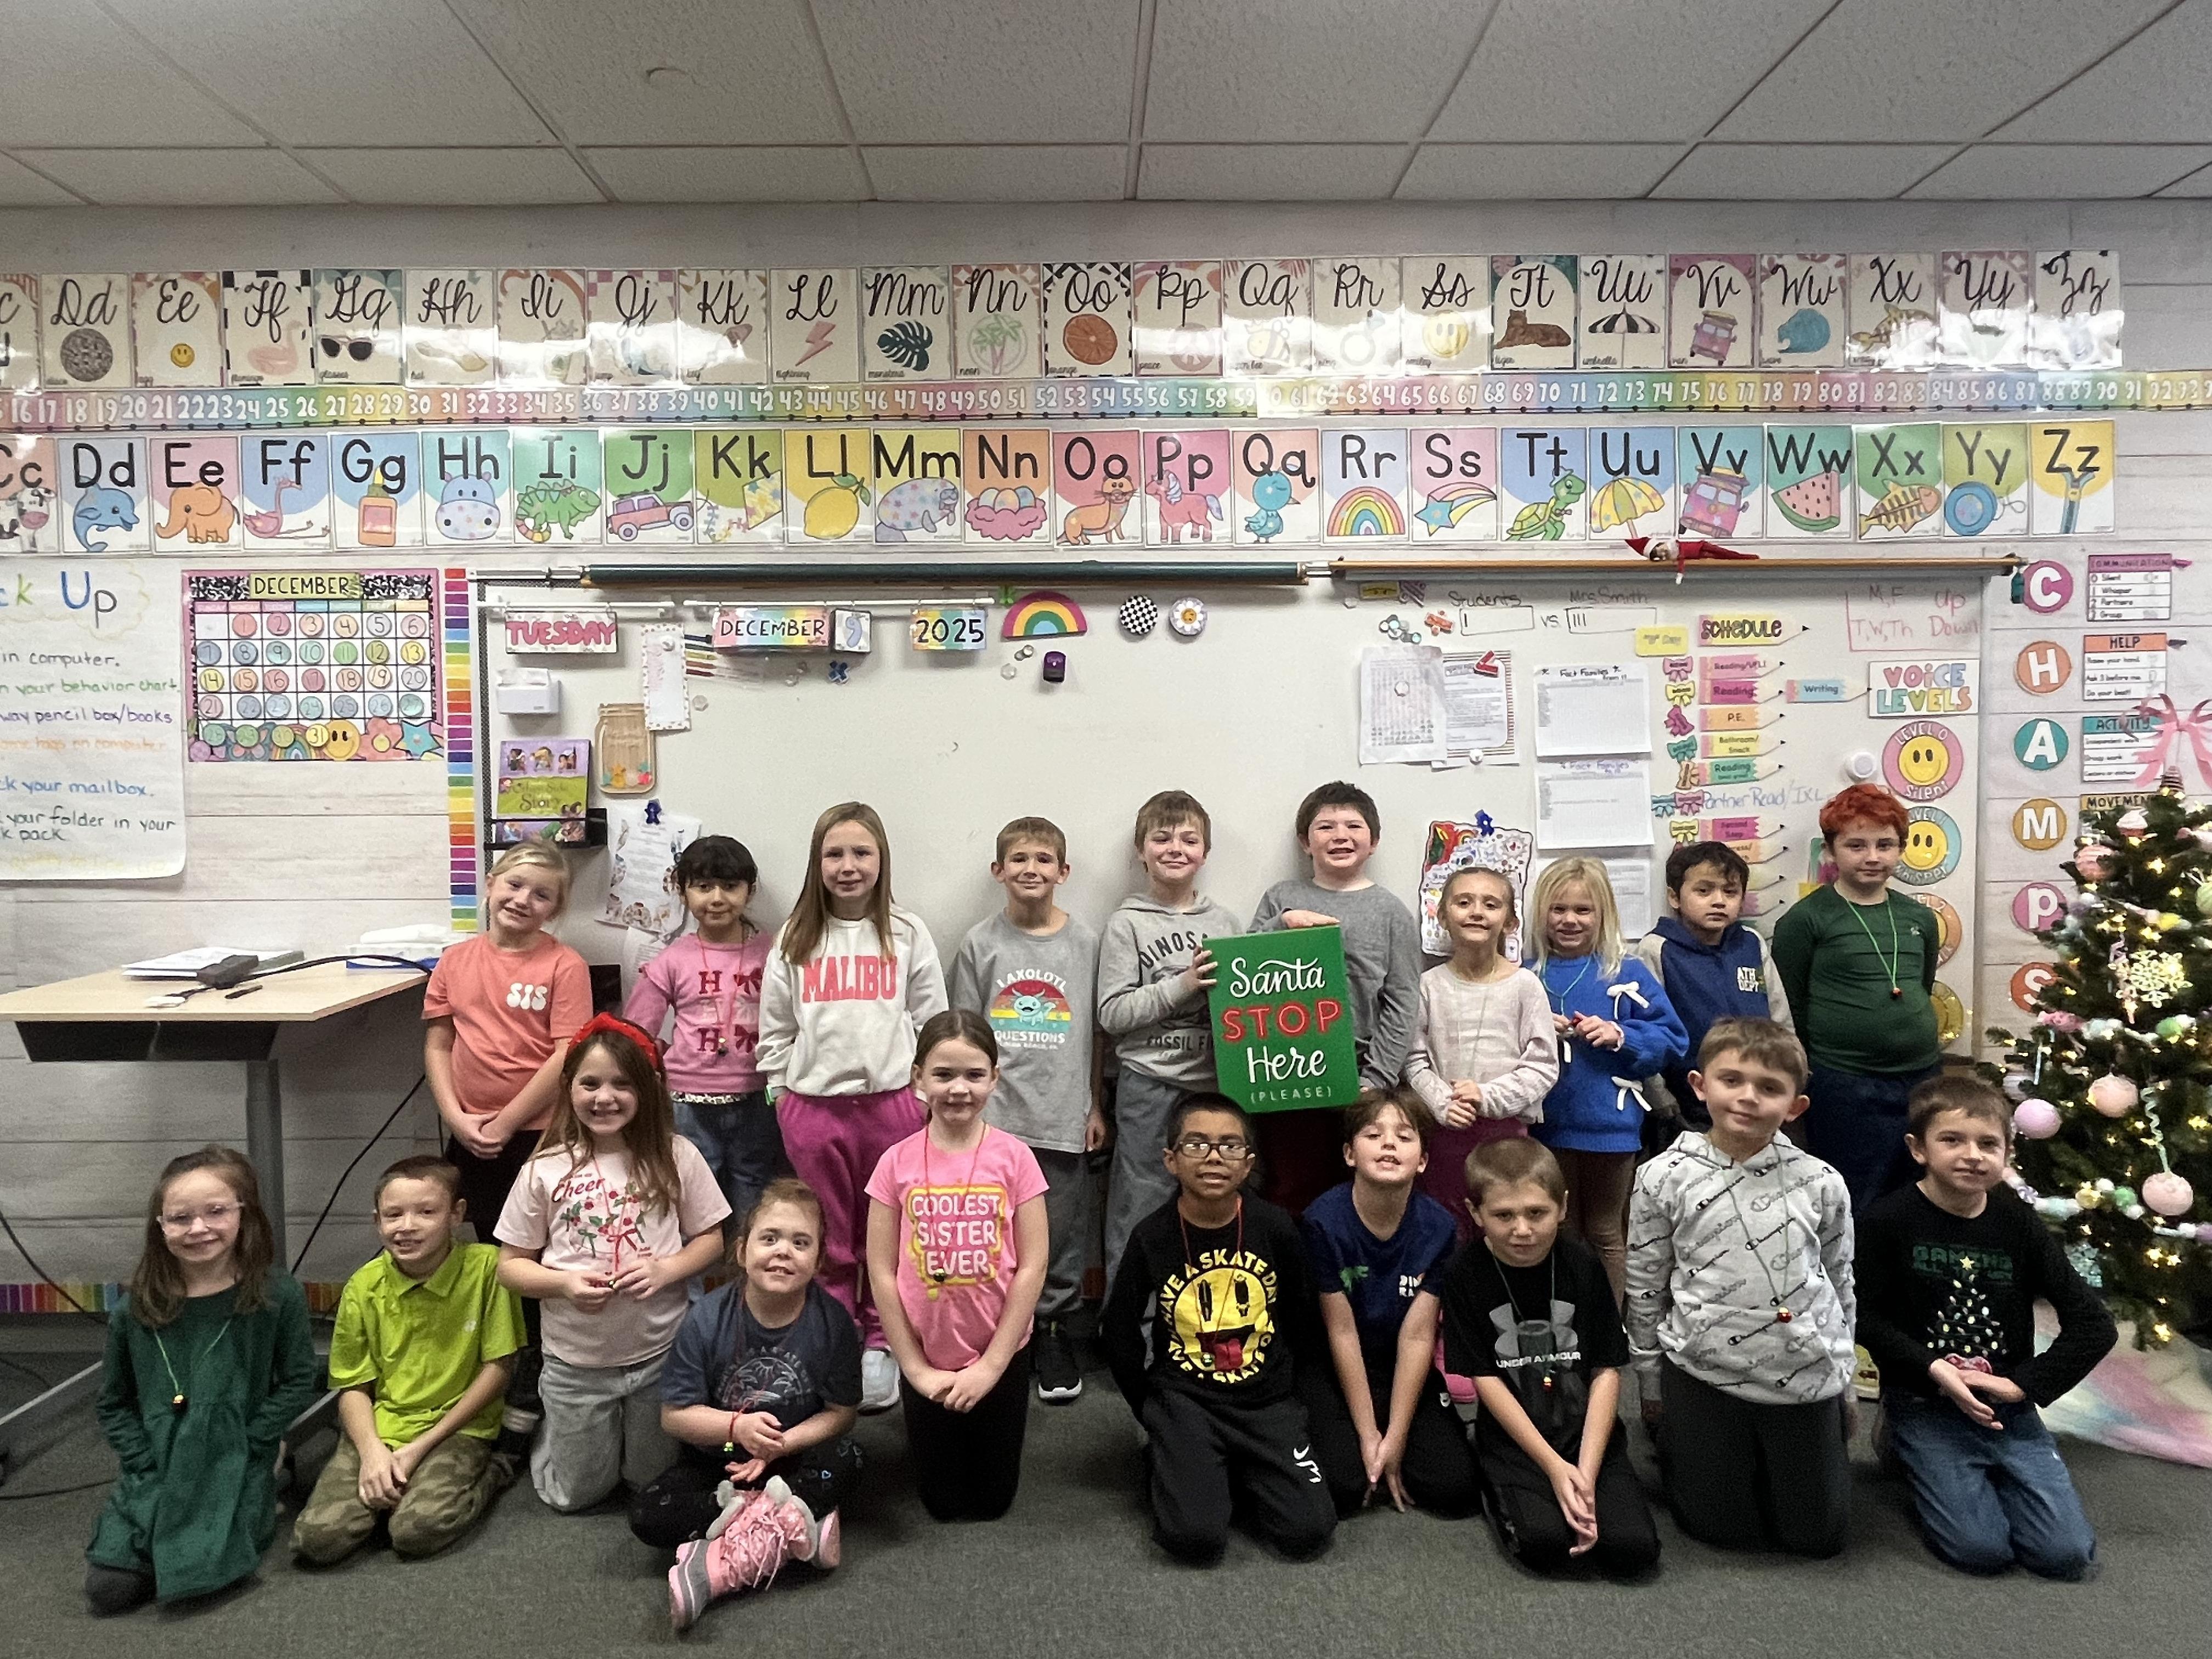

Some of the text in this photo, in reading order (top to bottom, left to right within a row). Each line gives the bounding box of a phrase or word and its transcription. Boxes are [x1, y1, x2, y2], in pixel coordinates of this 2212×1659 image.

[868, 272, 944, 317] Mm
[966, 268, 1026, 314] Nn
[1064, 269, 1118, 313] Oo
[1238, 263, 1298, 317] Qq
[1333, 264, 1384, 308] Rr
[1510, 263, 1554, 309] Tt
[1592, 259, 1652, 303] Uu
[1687, 264, 1740, 308] Vv
[1771, 264, 1837, 306] Ww
[1870, 256, 1922, 303] Xx
[1954, 259, 2014, 315] Yy
[51, 278, 117, 326] Dd
[157, 279, 200, 323] Ee
[245, 280, 289, 342] Ff
[325, 275, 392, 338] Gg
[417, 278, 482, 324] Hh
[521, 274, 563, 319] Ii
[697, 280, 749, 324] Kk
[786, 274, 837, 321] Ll
[1155, 266, 1209, 327] Pp
[442, 393, 458, 414] 31
[693, 391, 718, 411] 40
[894, 390, 917, 409] 47
[1036, 389, 1058, 407] 52
[1401, 383, 1421, 404] 65
[1539, 381, 1560, 402] 70
[1763, 381, 1782, 400] 78
[2125, 380, 2142, 399] 91
[12, 397, 32, 422] 16
[123, 395, 146, 419] 20
[266, 397, 289, 417] 25
[74, 443, 136, 488] Dd
[165, 443, 224, 487] Ee
[261, 440, 315, 484] Ff
[439, 437, 500, 480] Hh
[539, 436, 577, 478] Ii
[622, 435, 669, 492] Jj
[712, 435, 771, 478] Kk
[806, 435, 848, 478] Ll
[876, 435, 962, 478] Mm
[978, 435, 1038, 478] Nn
[1065, 436, 1128, 480] Oo
[1156, 436, 1214, 492] Pp
[1242, 433, 1316, 488] Qq
[1341, 435, 1397, 478] Rr
[1425, 433, 1481, 477] Ss
[1516, 432, 1567, 477] Tt
[1601, 432, 1659, 476] Uu
[1691, 432, 1747, 476] Vv
[1767, 432, 1852, 475] Ww
[1871, 433, 1926, 477] Xx
[1955, 431, 2010, 485] Yy
[2044, 428, 2100, 473] Zz
[341, 439, 406, 494] Gg
[61, 571, 117, 629] Up
[254, 577, 349, 595] DECEMBER
[1448, 590, 1521, 607] Students
[2032, 568, 2062, 607] C
[275, 614, 284, 631] 2
[307, 616, 318, 631] 3
[374, 618, 384, 631] 5
[506, 620, 615, 646] TUESDAY
[720, 617, 862, 647] DECEMBER 9
[917, 618, 985, 644] 2025
[303, 646, 320, 659] 10
[369, 644, 384, 659] 12
[2110, 637, 2140, 648] HELP
[29, 651, 120, 668] computer.
[2028, 650, 2059, 686] H
[16, 684, 54, 696] your
[61, 679, 135, 692] behavior
[205, 674, 219, 687] 14
[404, 672, 424, 685] 20
[1713, 686, 1753, 697] Reading
[1804, 685, 1838, 695] Writing
[1877, 686, 1972, 713] LEVELS
[35, 708, 86, 723] pencil
[1728, 713, 1745, 721] P.E.
[311, 727, 324, 743] 31
[1895, 722, 1932, 744] LEVEL
[2023, 721, 2057, 763] A
[1715, 764, 1751, 772] Reading
[22, 780, 155, 797] your mailbox.
[1906, 781, 1948, 799] Silent
[7, 805, 176, 832] your folder in your
[2022, 808, 2059, 839] M
[20, 829, 65, 843] pack
[1139, 931, 1207, 968] DINOS
[698, 970, 723, 994] H
[803, 956, 898, 1004] MALIBU
[1007, 969, 1066, 992] AXOLOTL
[1230, 957, 1325, 998] Santa
[1737, 967, 1756, 981] ATH
[1737, 980, 1759, 992] DEPT
[507, 982, 547, 1011] SIS
[1223, 1000, 1340, 1039] STOP
[697, 1028, 720, 1052] H
[994, 1031, 1065, 1043] QUESTIONS
[1246, 1047, 1327, 1083] Here
[1250, 1086, 1331, 1103] (PLEASE)
[552, 1178, 605, 1202] Cheer
[912, 1194, 1002, 1217] COOLEST
[917, 1220, 997, 1246] SISTER
[926, 1250, 989, 1276] EVER
[1185, 1263, 1199, 1279] A
[1199, 1248, 1268, 1275] SKATE
[1496, 1352, 1581, 1368] UNDER ARMOUR
